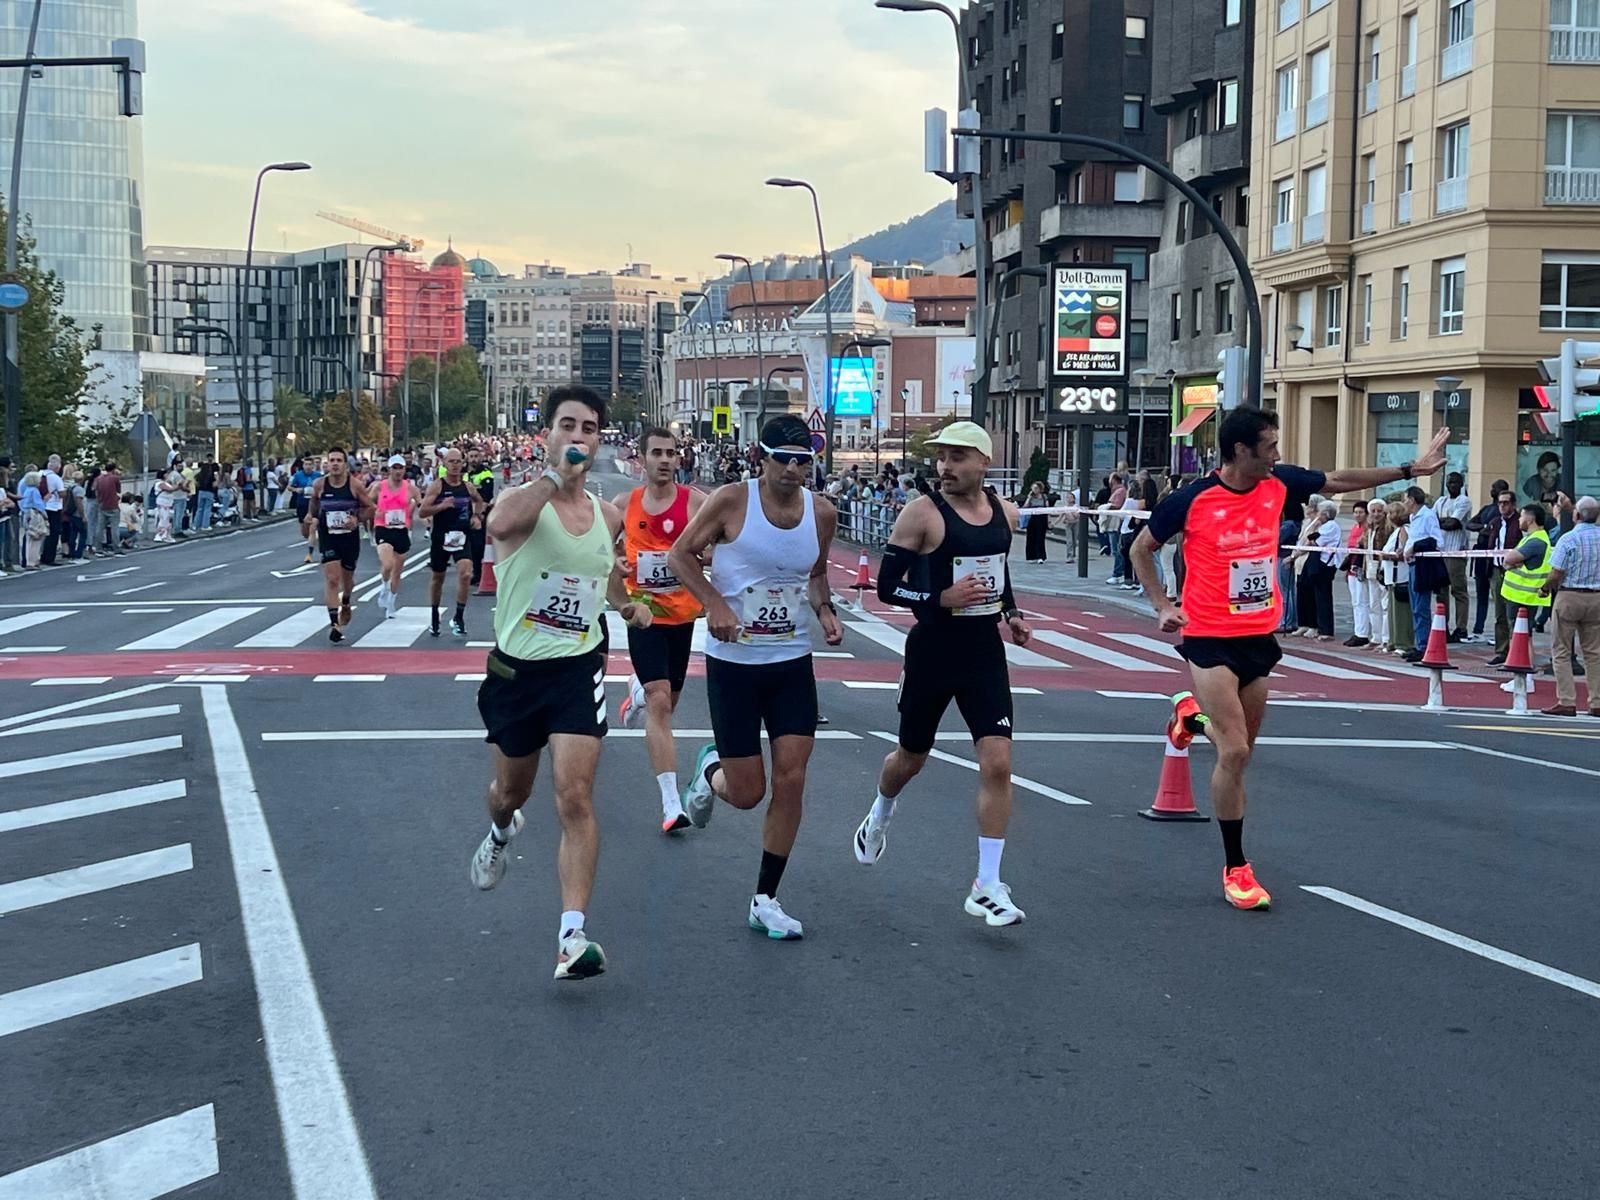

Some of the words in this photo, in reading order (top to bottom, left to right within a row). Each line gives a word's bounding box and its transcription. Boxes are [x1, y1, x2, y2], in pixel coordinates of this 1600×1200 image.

[1060, 271, 1122, 285] Voll-Damm
[716, 318, 790, 334] COMERCIA
[677, 336, 797, 357] ZUBARTE
[652, 567, 667, 578] 61
[1243, 576, 1267, 590] 393
[547, 596, 580, 615] 231
[758, 607, 788, 620] 263
